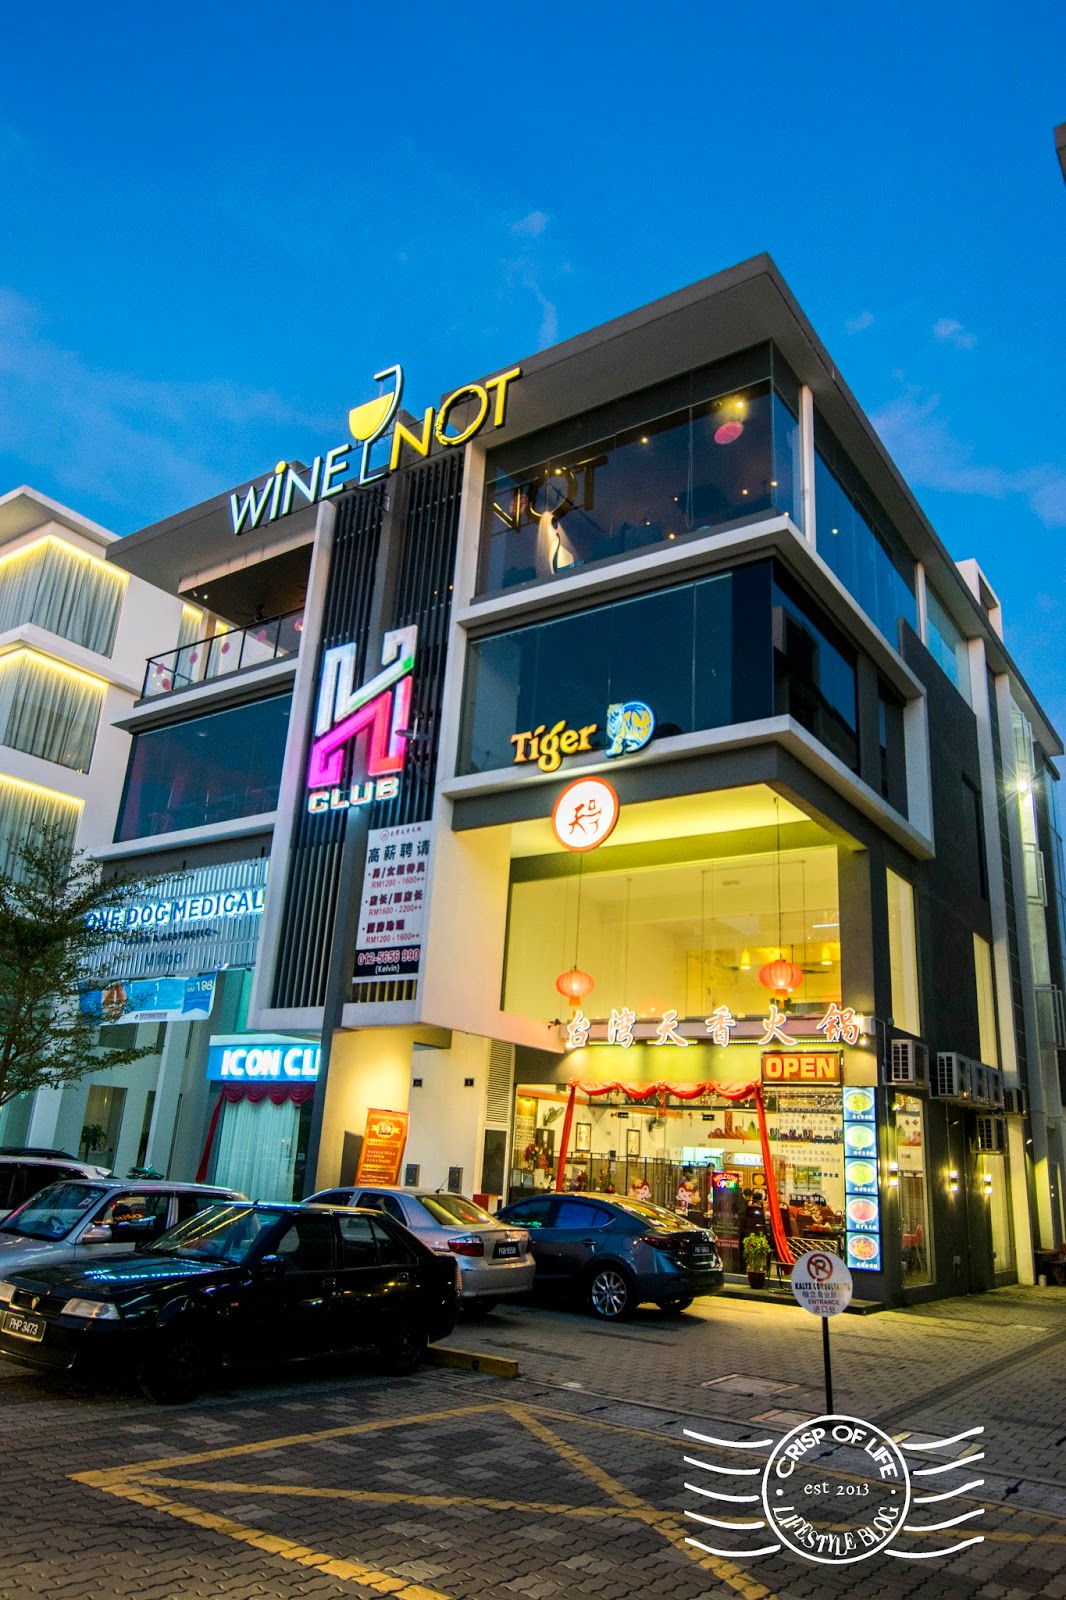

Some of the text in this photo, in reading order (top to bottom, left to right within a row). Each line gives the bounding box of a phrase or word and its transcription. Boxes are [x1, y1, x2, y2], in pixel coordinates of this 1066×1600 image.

[389, 367, 522, 472] NOT
[510, 720, 598, 772] Tiger
[307, 776, 400, 814] CLUB
[368, 839, 430, 864] 高薪聘请
[172, 889, 264, 921] MEDICAL
[357, 947, 420, 965] 012-5656 990
[375, 964, 400, 974] (Kelvin)
[220, 1049, 281, 1076] ICON
[765, 1057, 836, 1079] OPEN
[713, 1173, 738, 1182] WELCOME
[717, 1180, 736, 1189] OPEN
[9, 1317, 39, 1335] PHP 3473
